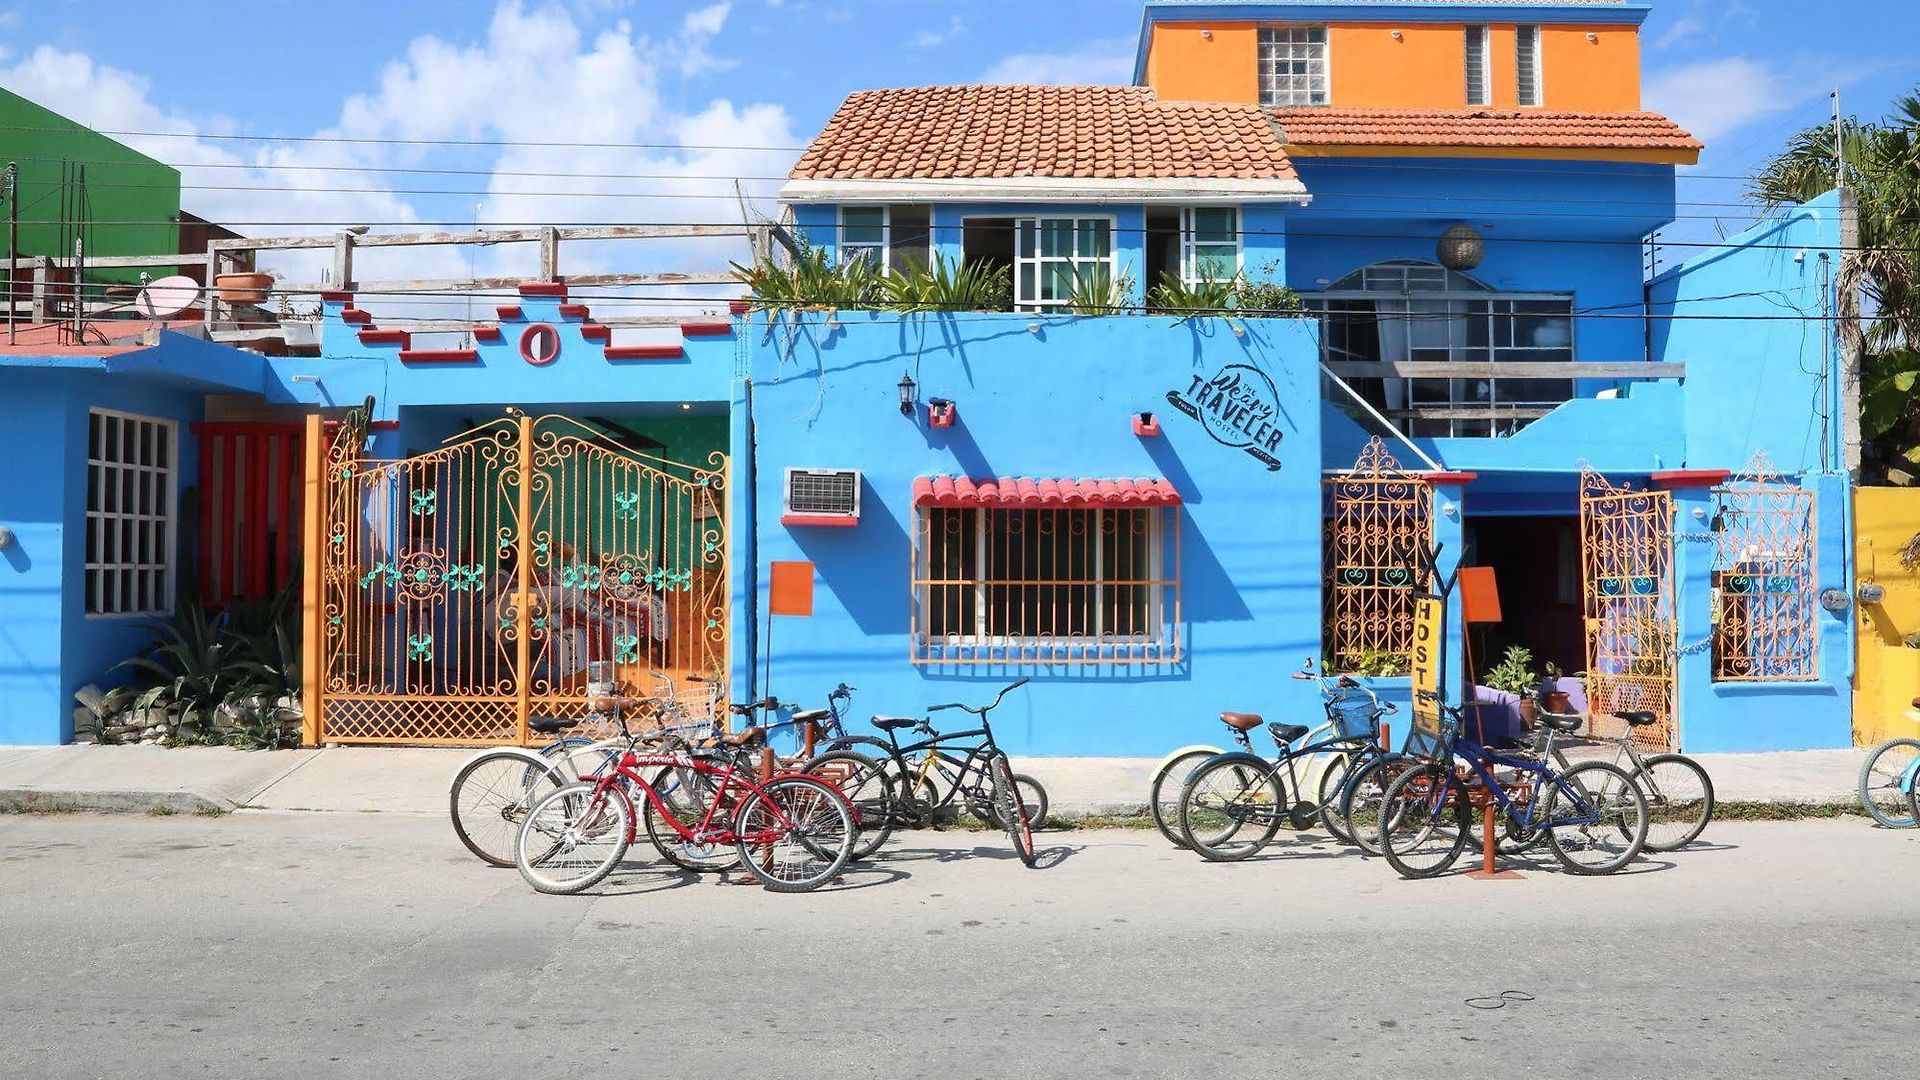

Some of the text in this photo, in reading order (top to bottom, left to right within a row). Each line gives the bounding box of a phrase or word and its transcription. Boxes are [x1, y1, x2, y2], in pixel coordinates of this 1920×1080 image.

[1211, 373, 1273, 421] Weary
[1243, 384, 1257, 396] THE
[1187, 374, 1283, 451] TRAVELER
[1210, 416, 1239, 439] HOSTEL
